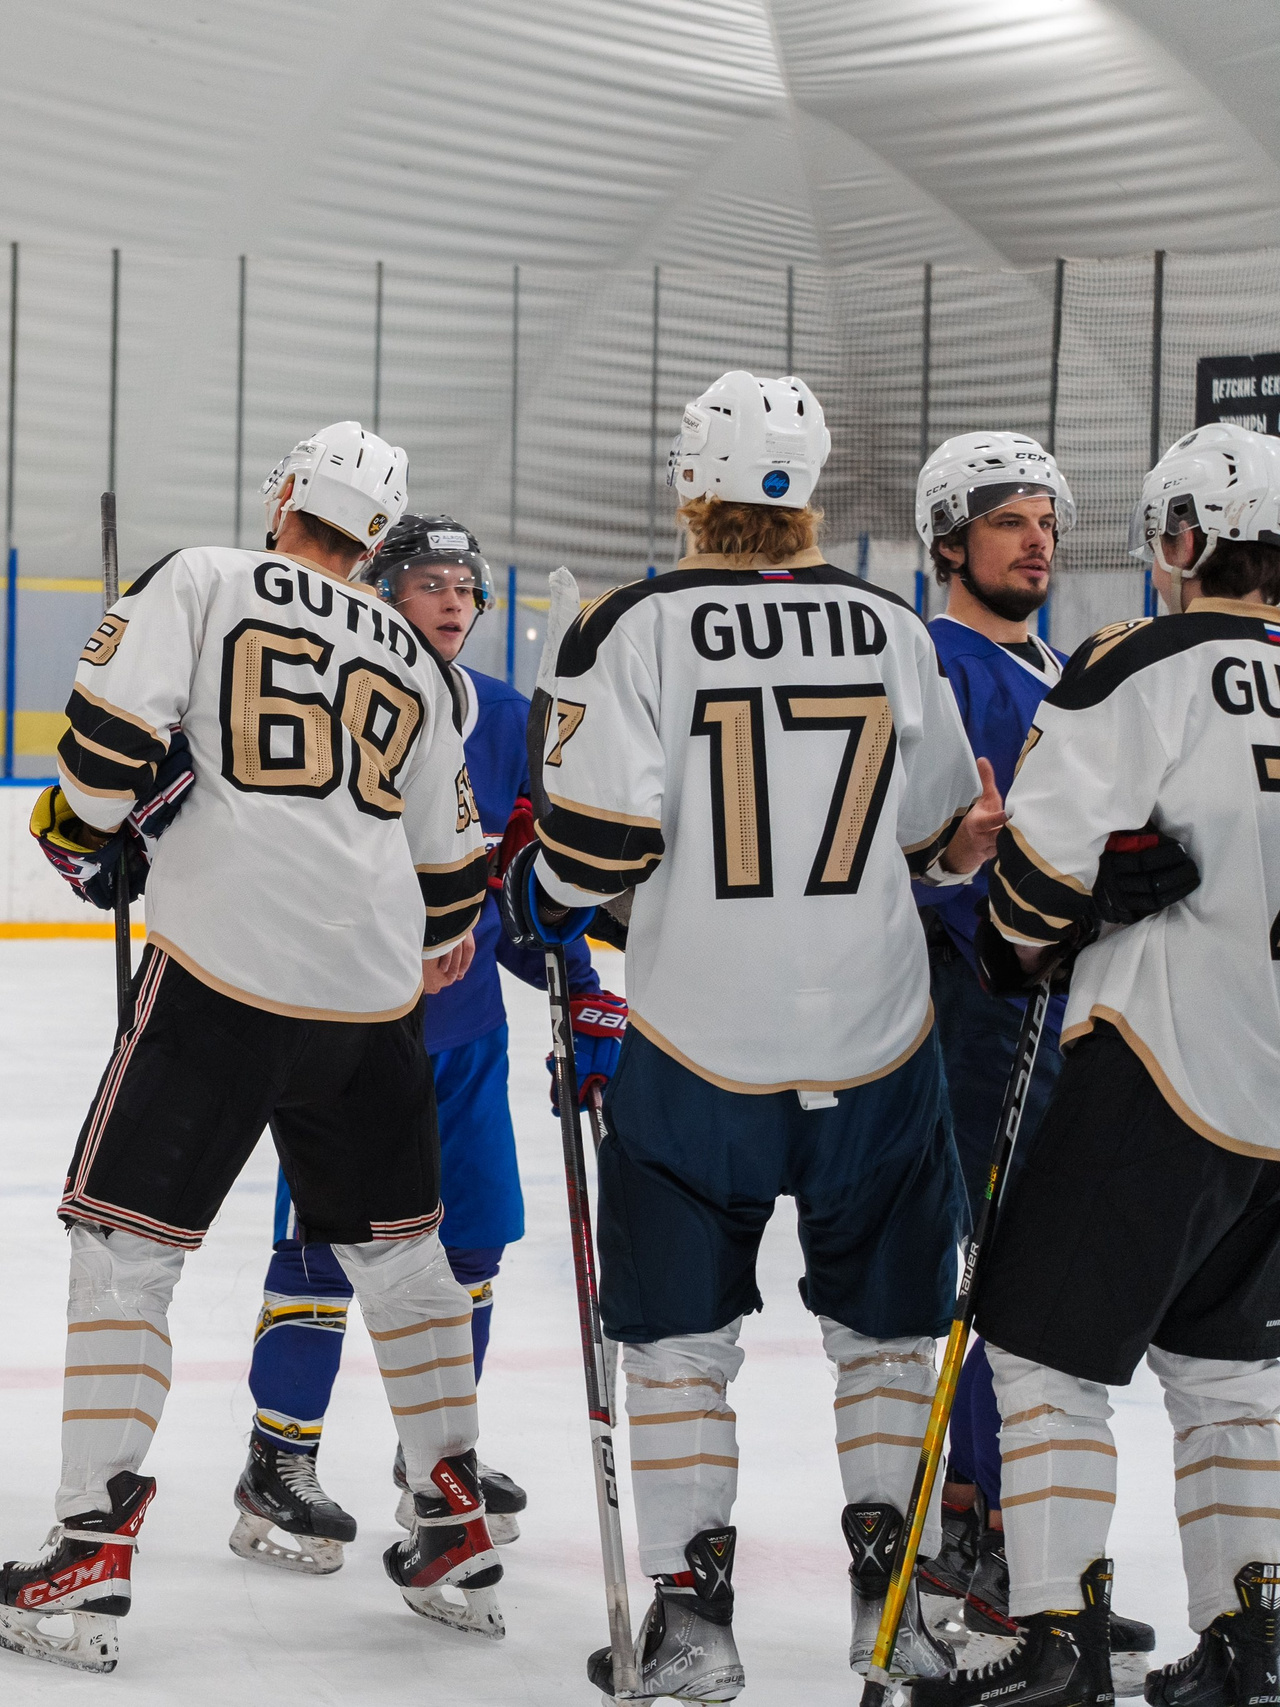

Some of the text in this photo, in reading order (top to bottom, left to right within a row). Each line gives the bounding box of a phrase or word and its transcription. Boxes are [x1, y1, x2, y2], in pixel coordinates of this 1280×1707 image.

[1015, 452, 1047, 463] CCM
[926, 482, 948, 497] CCM
[253, 561, 418, 668] GUTID
[691, 601, 887, 661] GUTID
[219, 618, 424, 820] 68
[690, 683, 898, 899] 17
[440, 1471, 472, 1507] CCM
[129, 1490, 155, 1532] CCM
[404, 1552, 422, 1570] CCM
[23, 1560, 105, 1606] CCM
[981, 1680, 1027, 1702] BAUER
[1174, 1679, 1198, 1698] BAUER
